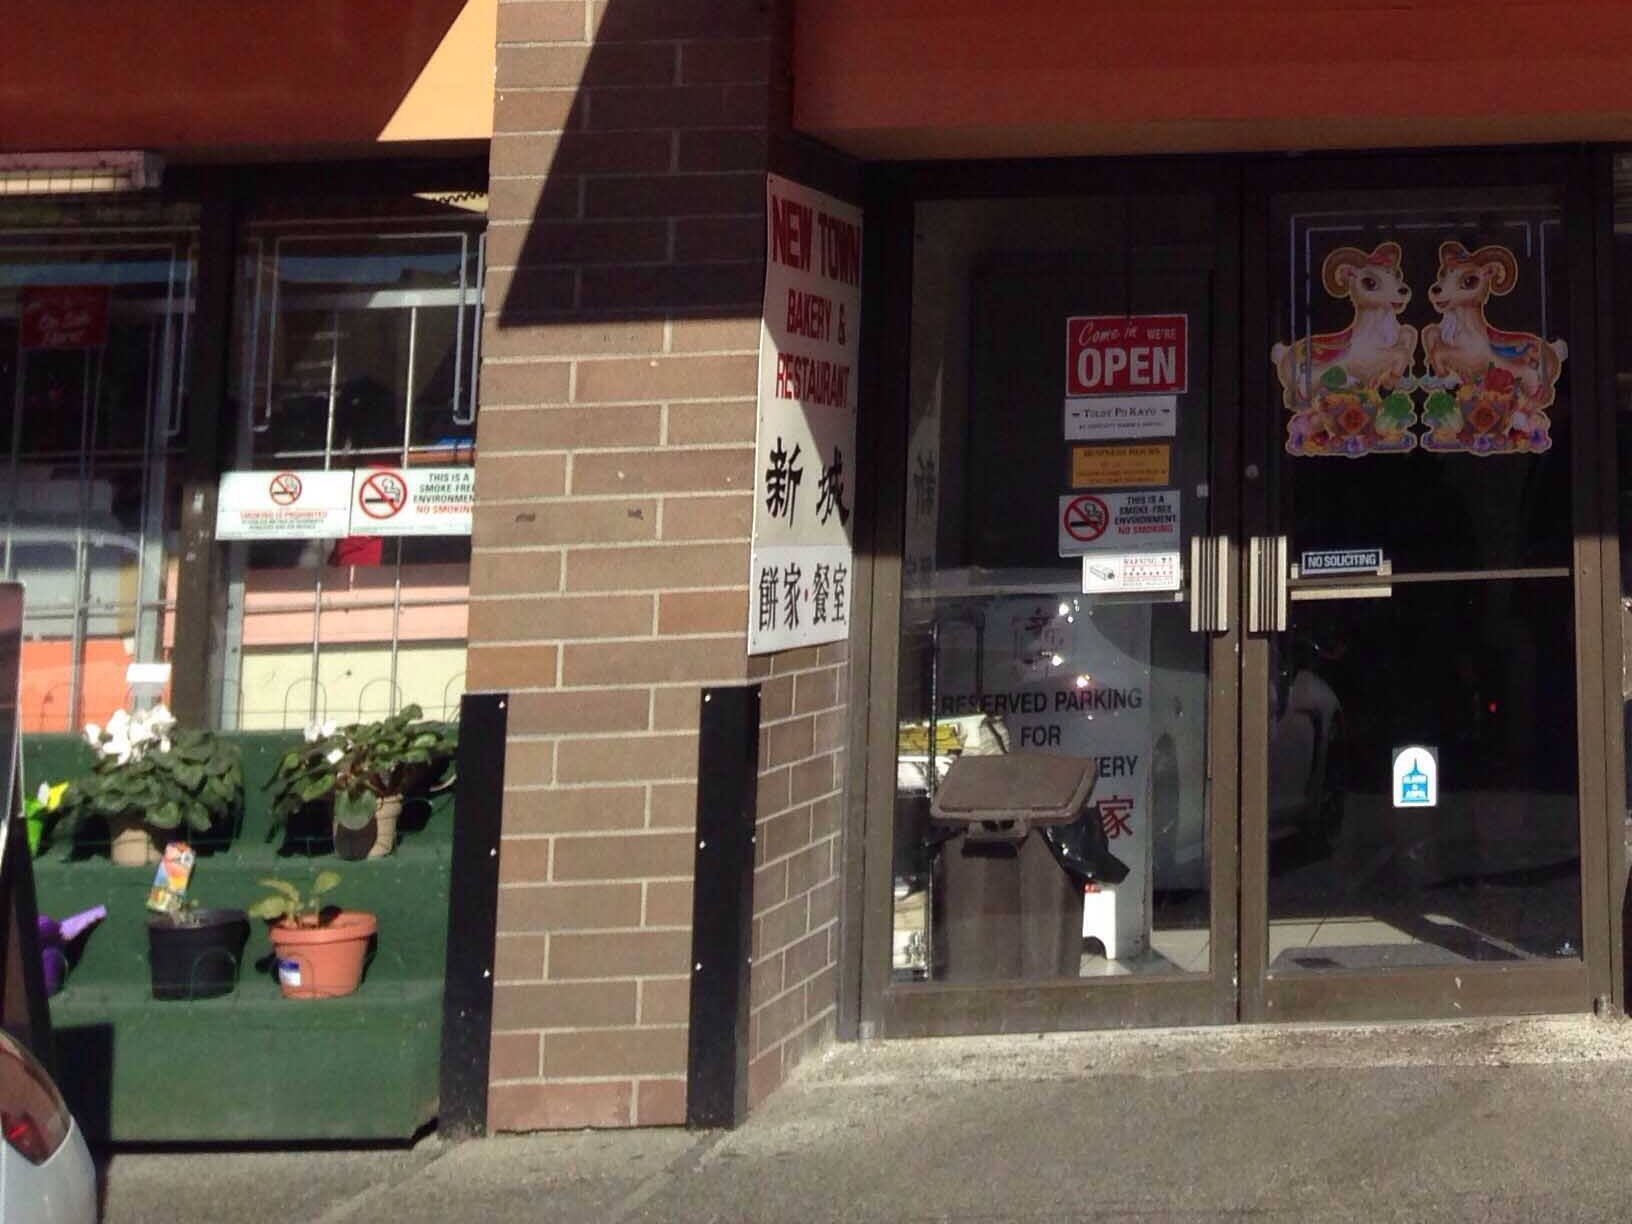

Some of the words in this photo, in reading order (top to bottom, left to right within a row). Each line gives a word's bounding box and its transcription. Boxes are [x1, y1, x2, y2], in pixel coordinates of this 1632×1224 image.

[771, 194, 813, 270] NEW
[817, 210, 860, 287] TOWN
[786, 289, 831, 342] BAKERY
[838, 302, 847, 346] &
[1079, 321, 1120, 346] Come
[1078, 346, 1176, 388] OPEN
[775, 352, 850, 409] RESTAURANT
[419, 483, 475, 493] SMOKE-FRE
[429, 473, 449, 482] THIS
[452, 473, 460, 481] IS
[463, 472, 470, 481] A
[413, 494, 475, 504] ENVIRONMEN
[416, 504, 430, 514] NO
[431, 504, 472, 513] SMOKIN
[1158, 495, 1165, 504] A
[1308, 556, 1322, 568] NO
[1324, 553, 1376, 567] SOLICITING
[942, 692, 1048, 714] RESERVED
[1055, 688, 1143, 711] PARKING
[1021, 726, 1061, 747] FOR
[1093, 755, 1138, 778] ERY
